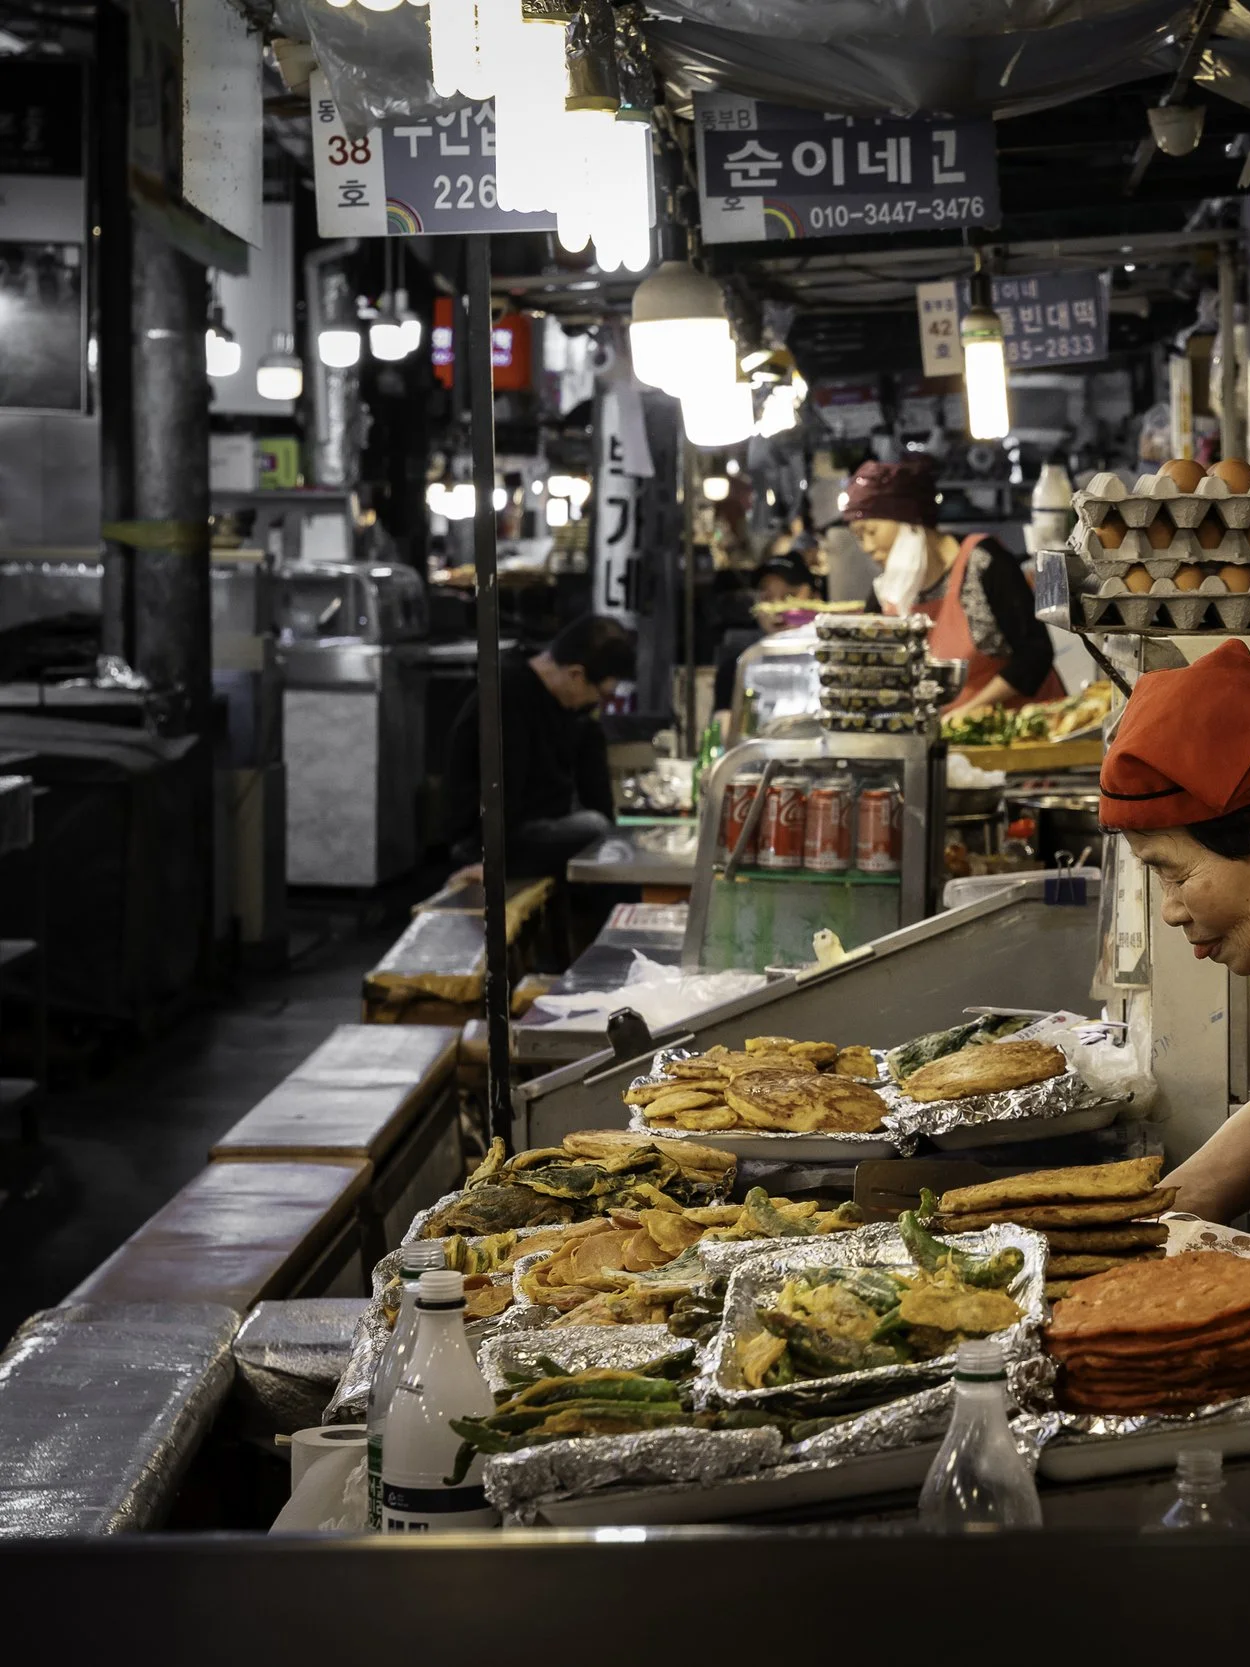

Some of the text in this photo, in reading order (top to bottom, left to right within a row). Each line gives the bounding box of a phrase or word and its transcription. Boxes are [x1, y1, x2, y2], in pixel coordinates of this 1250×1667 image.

[328, 135, 371, 165] 38
[338, 180, 370, 208] 호
[810, 197, 984, 229] 010-3447-3476
[929, 319, 952, 336] 42
